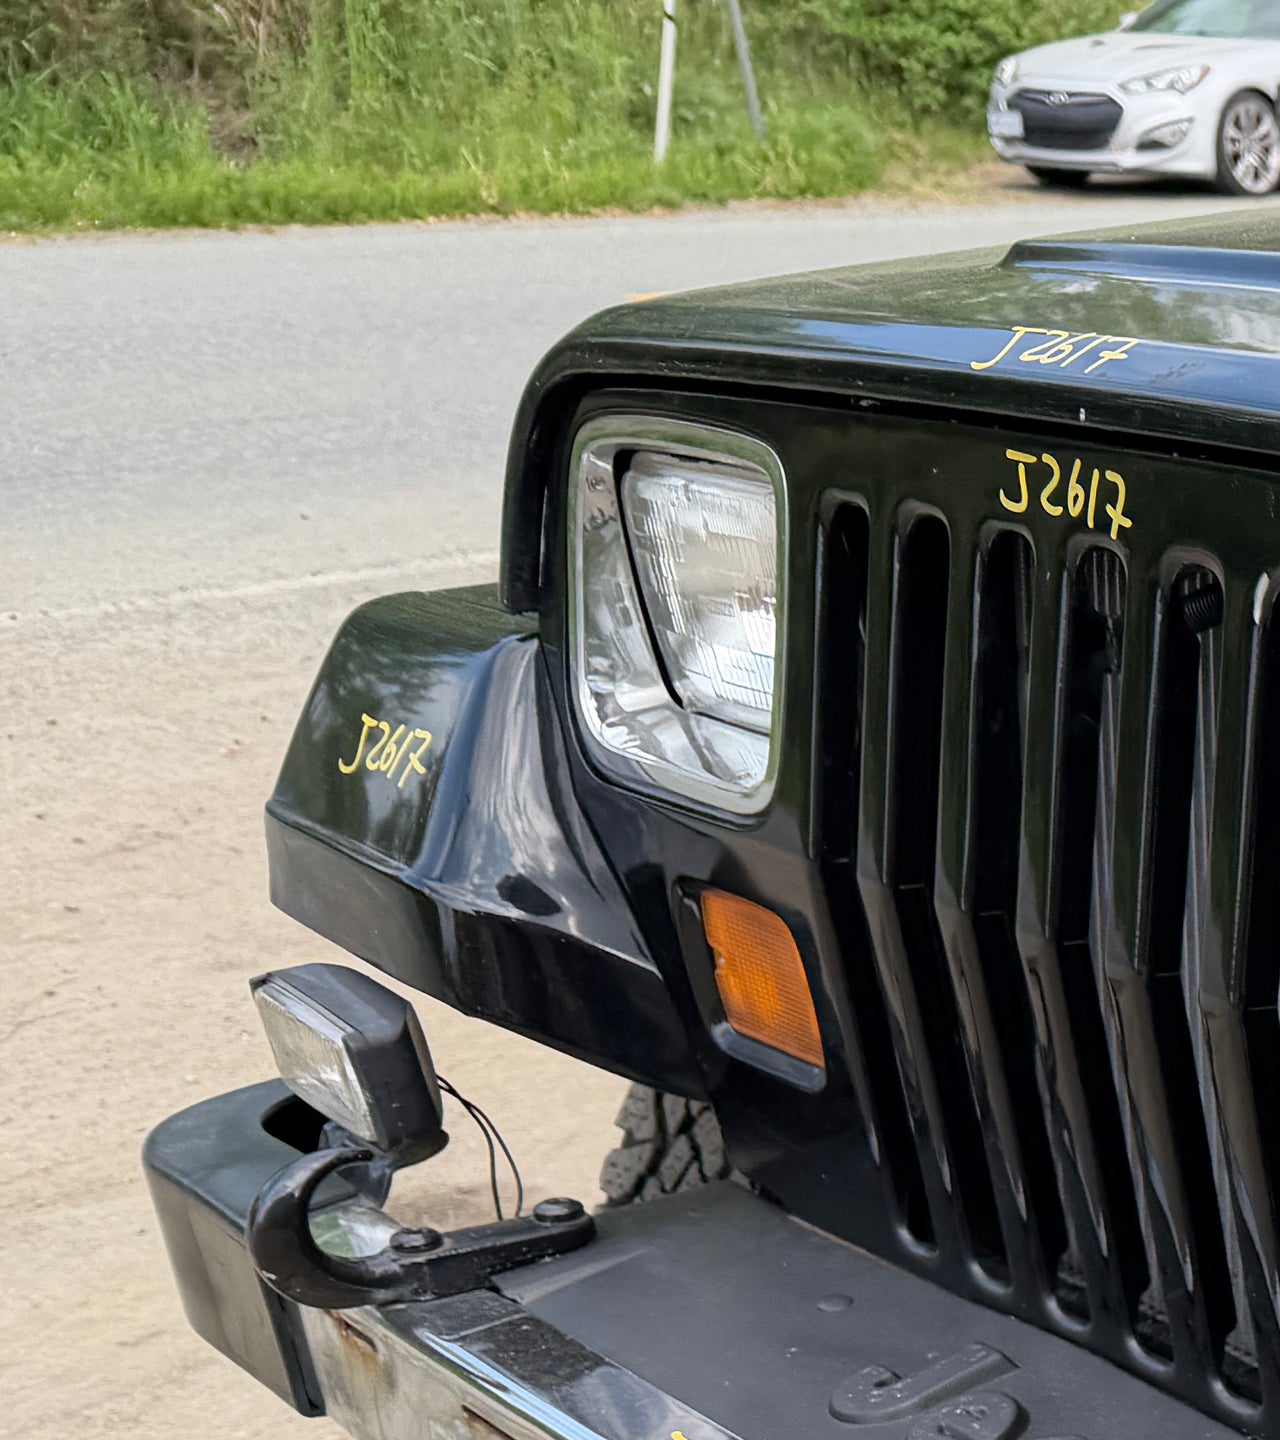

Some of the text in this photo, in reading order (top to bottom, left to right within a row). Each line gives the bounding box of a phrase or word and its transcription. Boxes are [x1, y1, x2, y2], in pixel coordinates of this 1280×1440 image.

[971, 325, 1140, 373] J2617
[999, 448, 1135, 541] J2617
[338, 712, 429, 789] J2617
